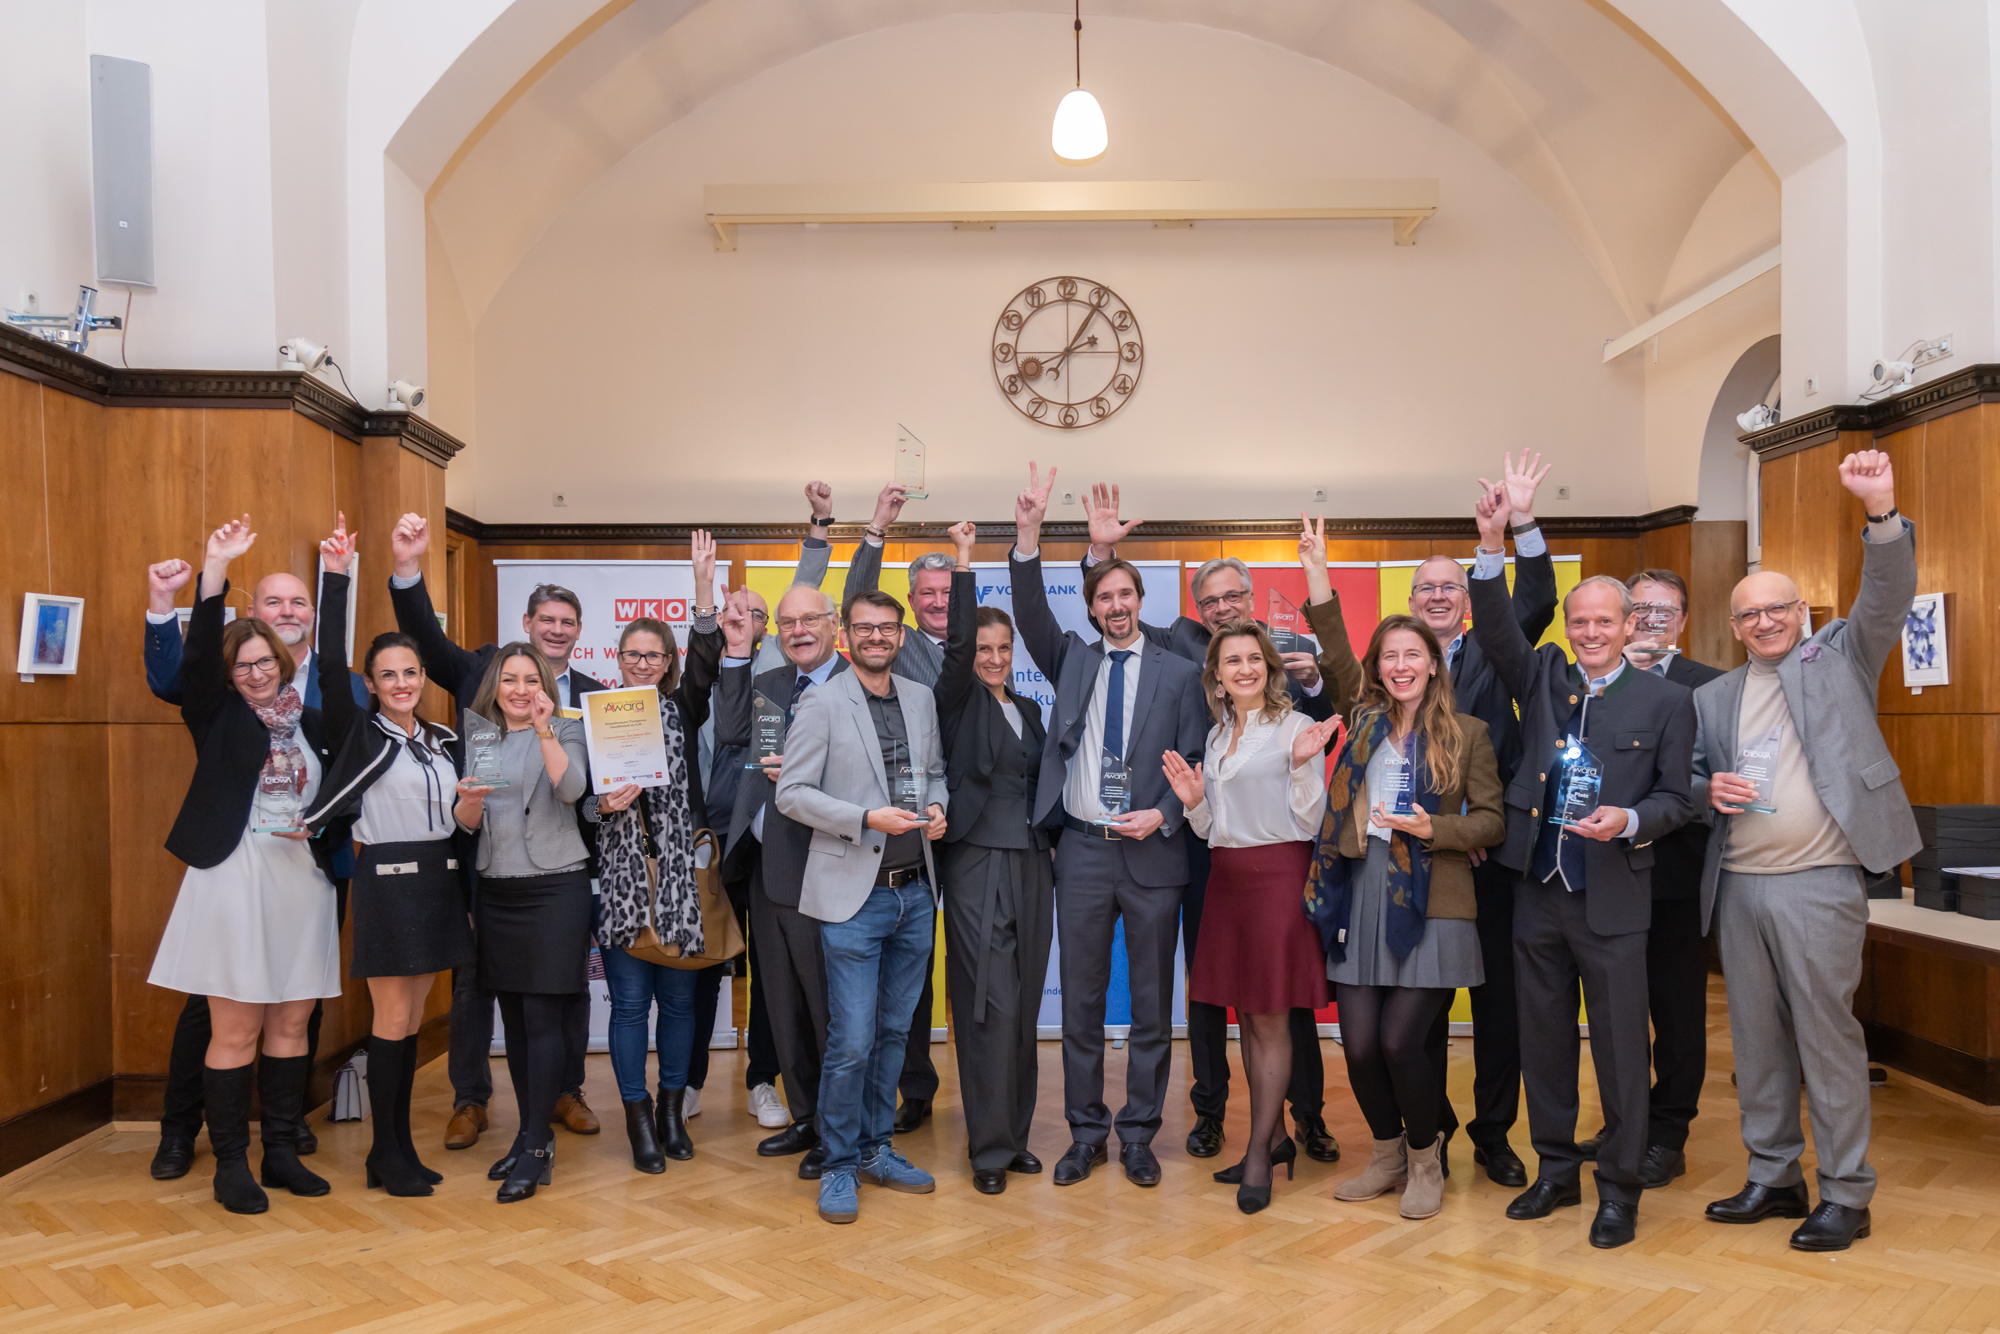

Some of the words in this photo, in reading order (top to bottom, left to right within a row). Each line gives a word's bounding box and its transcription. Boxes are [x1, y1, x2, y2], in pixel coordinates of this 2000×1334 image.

[1027, 288, 1040, 307] 11
[1060, 280, 1075, 299] 12
[1003, 314, 1022, 329] 10
[1118, 312, 1129, 329] 2
[999, 344, 1011, 363] 9
[1126, 343, 1137, 363] 3
[1008, 376, 1019, 395] 8
[1116, 377, 1129, 395] 4
[1031, 400, 1044, 418] 7
[1063, 406, 1074, 427] 6
[1096, 398, 1106, 417] 5
[996, 585, 1077, 596] VOANK
[616, 601, 684, 619] WKO
[1273, 613, 1294, 621] Award
[757, 715, 781, 723] Award
[471, 732, 496, 741] Award
[900, 766, 924, 774] Award
[1103, 771, 1128, 780] Award
[1567, 764, 1598, 776] Award
